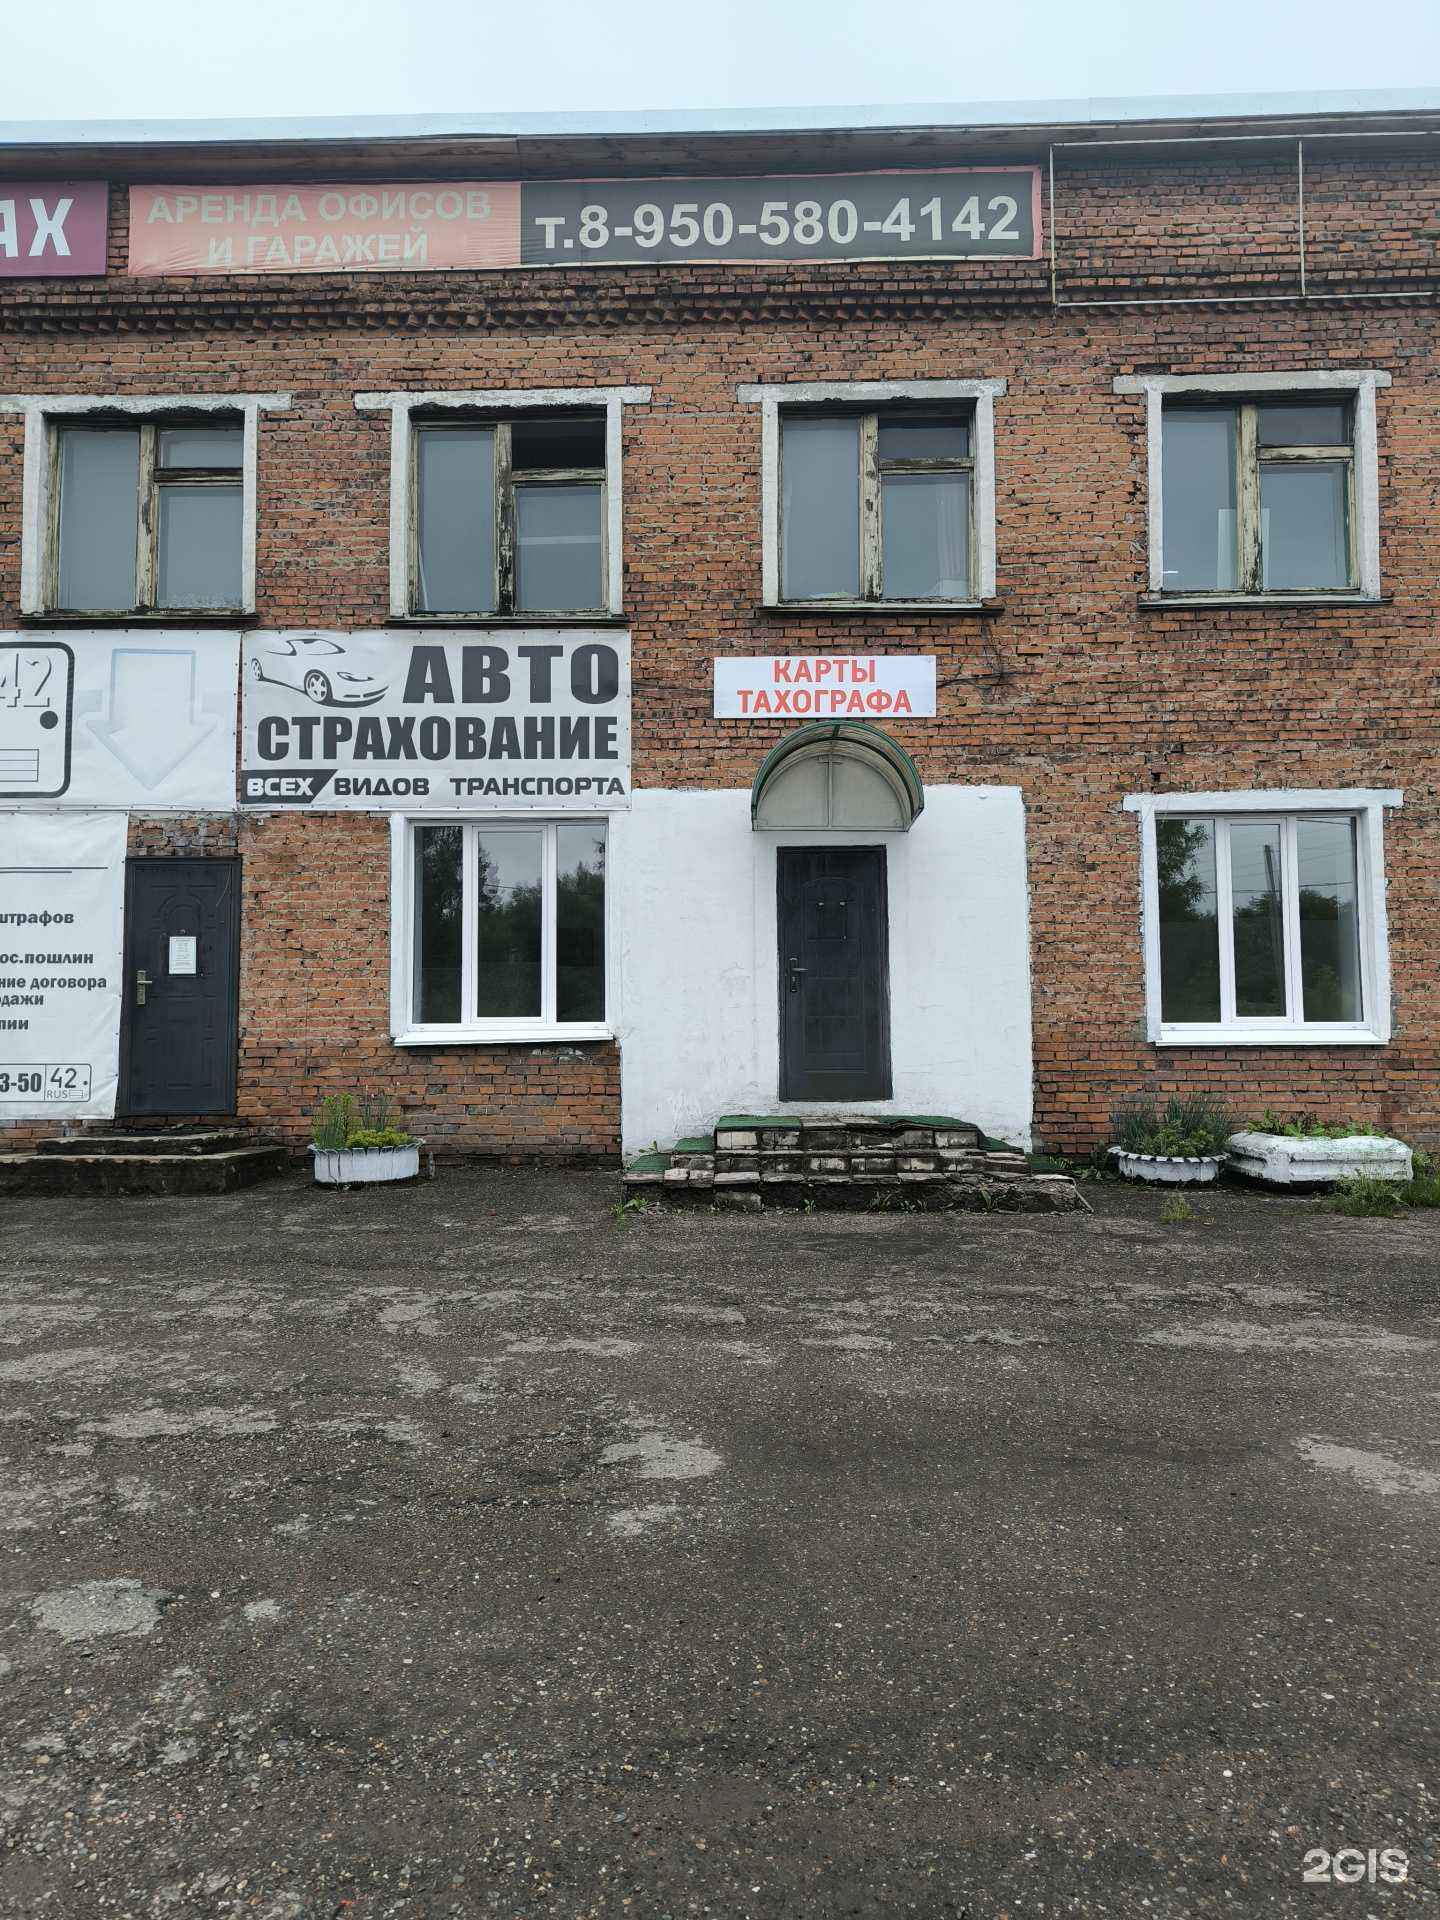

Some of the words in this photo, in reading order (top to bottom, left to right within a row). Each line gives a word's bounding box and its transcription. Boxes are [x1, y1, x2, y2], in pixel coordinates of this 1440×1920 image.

[146, 194, 307, 228] АРЕНДА
[318, 189, 493, 223] ОФИСОВ
[207, 236, 233, 267] И
[246, 226, 429, 264] ГАРАЖЕЙ
[402, 644, 619, 704] АВТО
[773, 659, 875, 683] КАРТЫ
[737, 689, 912, 713] ТАХОГРАФА
[257, 715, 619, 761] СТРАХОВАНИЕ
[246, 776, 315, 797] ВСЕХ
[334, 776, 430, 796] ВИДОВ
[449, 776, 626, 796] ТРАНСПОРТА
[30, 977, 107, 990] договора
[0, 994, 44, 1007] дажи
[50, 1067, 77, 1088] 42
[47, 1089, 68, 1098] RUS
